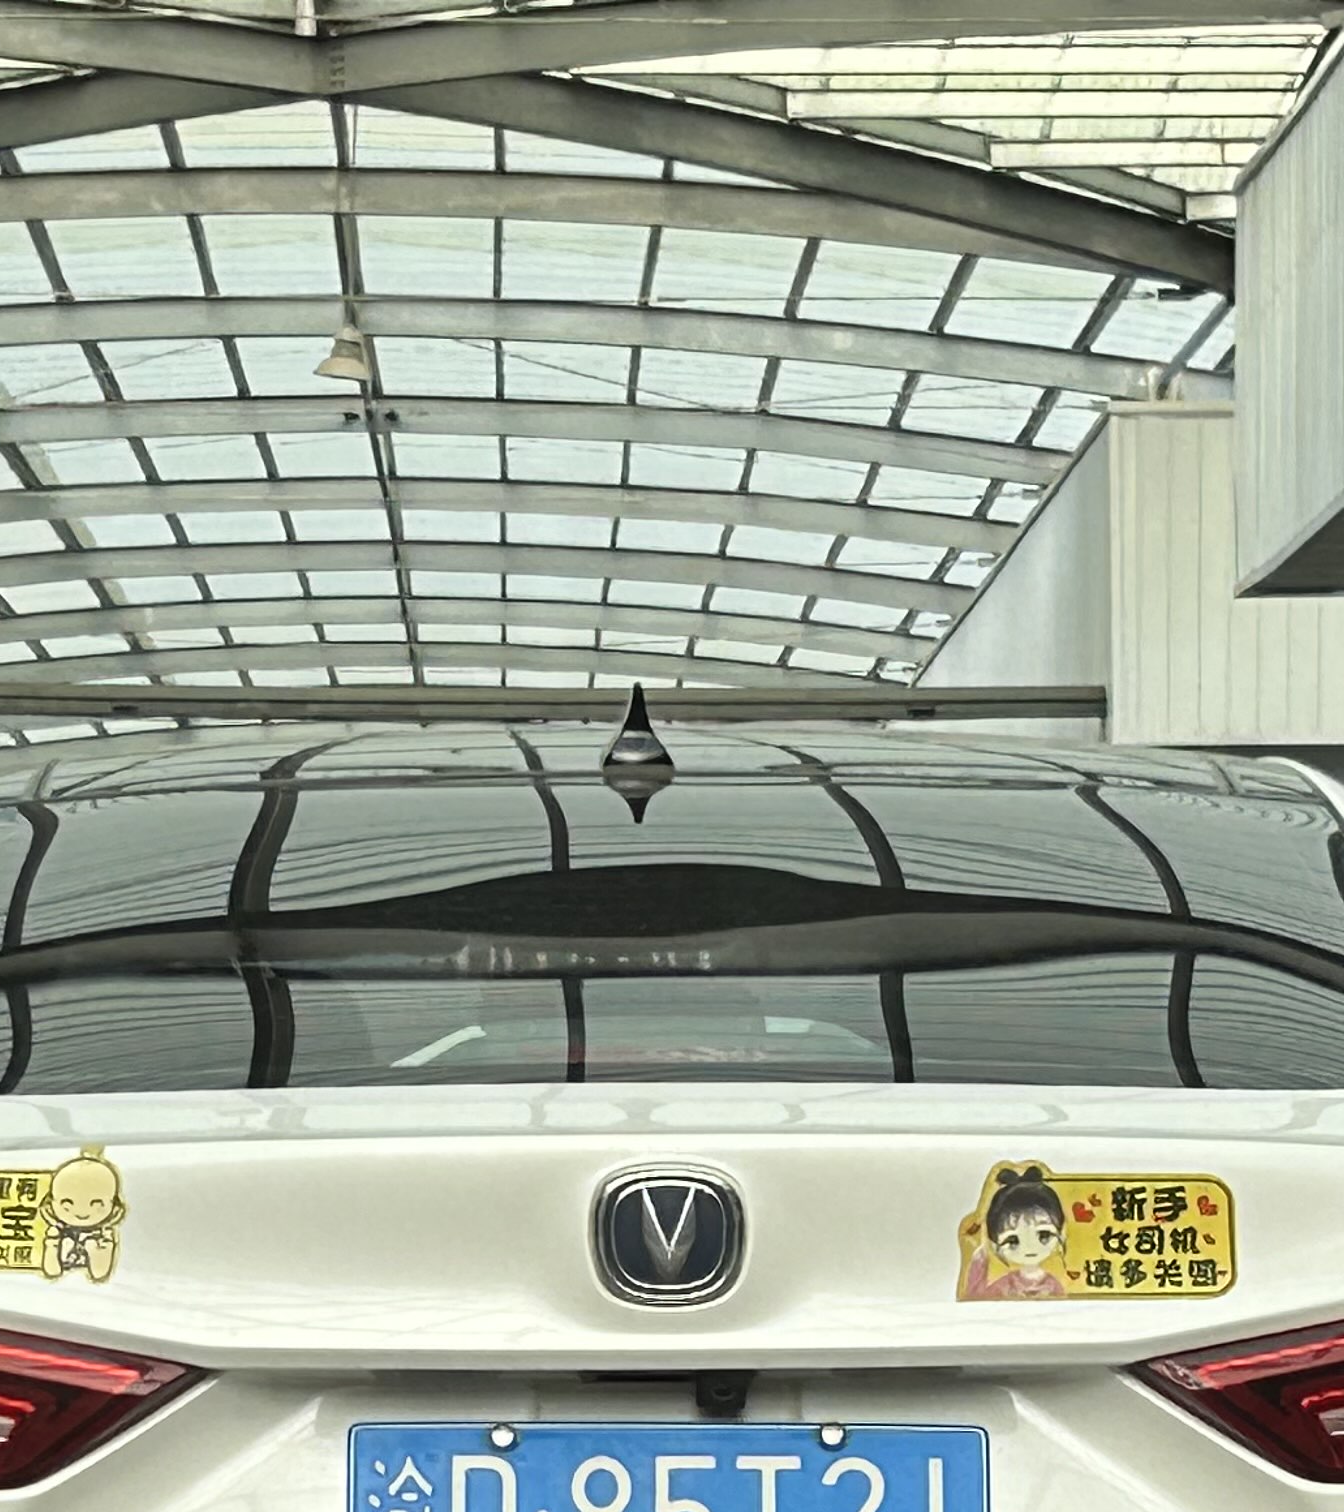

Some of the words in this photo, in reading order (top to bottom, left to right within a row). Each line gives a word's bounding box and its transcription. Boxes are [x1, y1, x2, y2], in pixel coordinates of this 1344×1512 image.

[1111, 1185, 1188, 1222] 新手
[1099, 1225, 1200, 1255] 女司机
[1084, 1257, 1217, 1288] 请多关照
